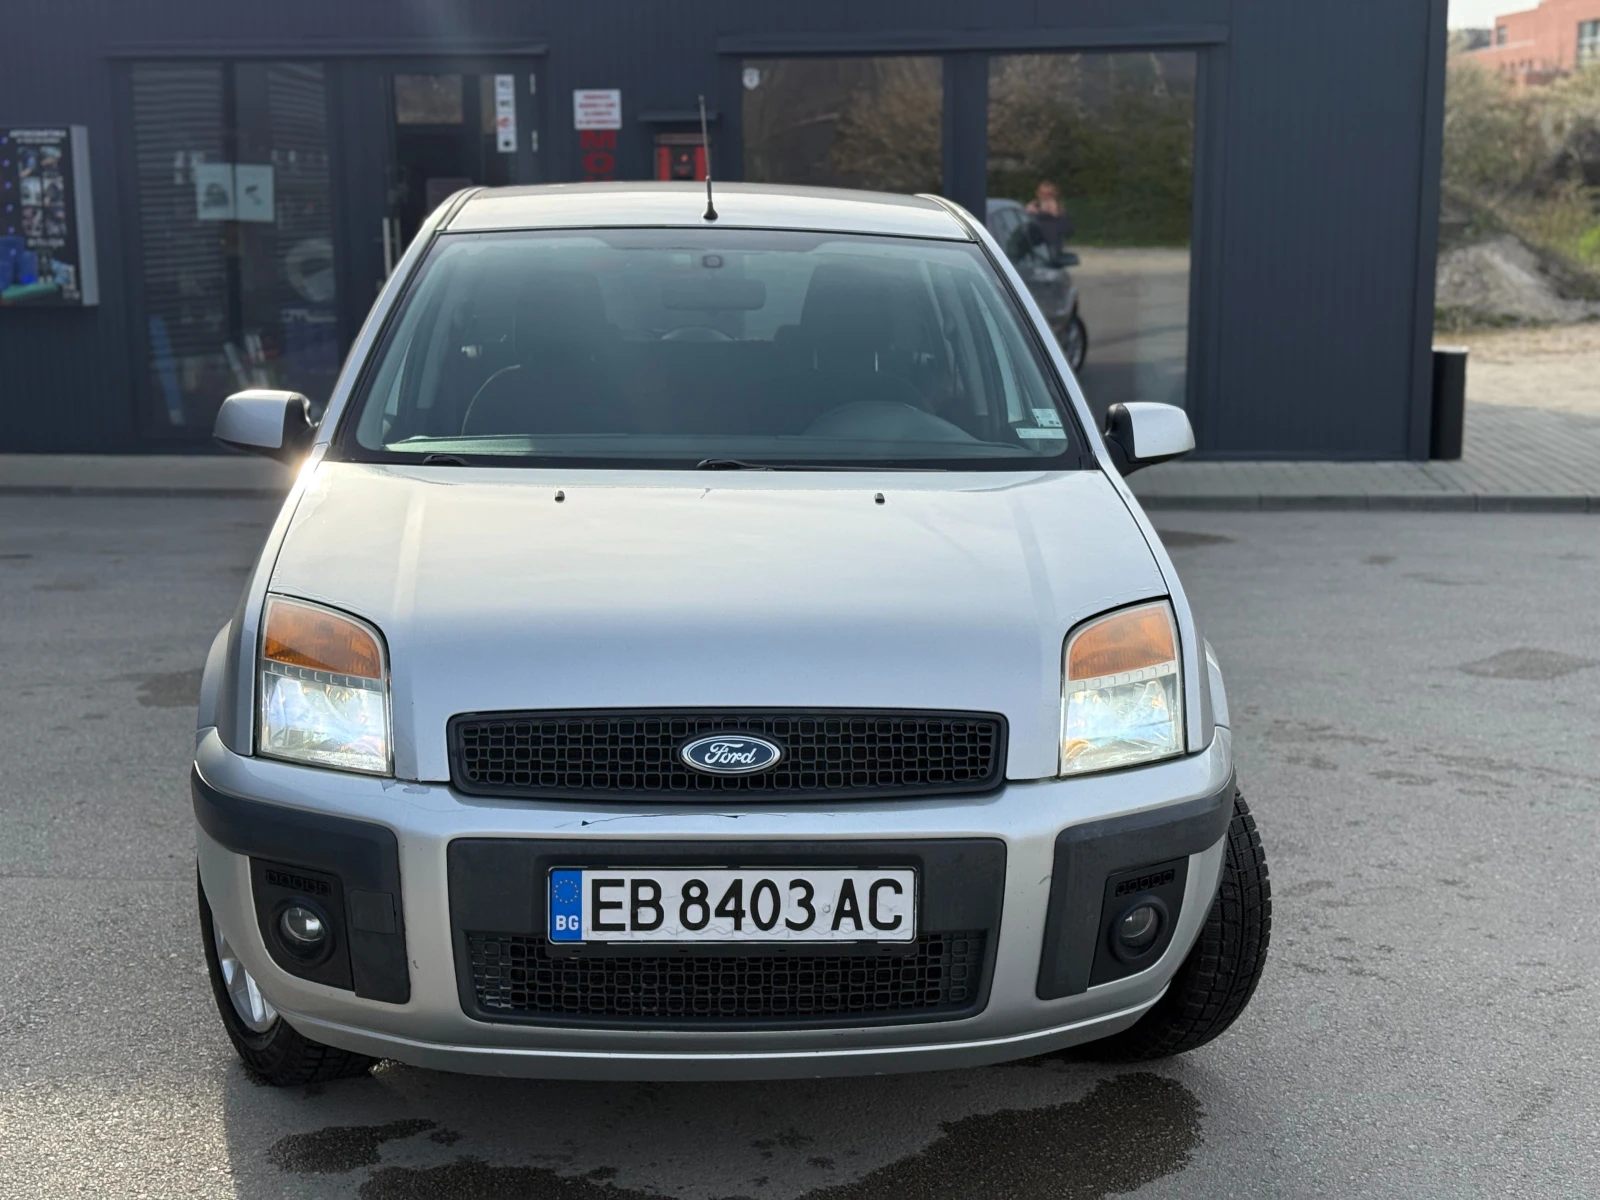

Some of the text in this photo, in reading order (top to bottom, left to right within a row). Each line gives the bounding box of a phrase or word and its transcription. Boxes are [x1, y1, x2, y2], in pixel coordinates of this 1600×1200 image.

[704, 742, 757, 764] Ford
[591, 879, 903, 931] EB 8403 AC
[556, 915, 579, 930] BG
